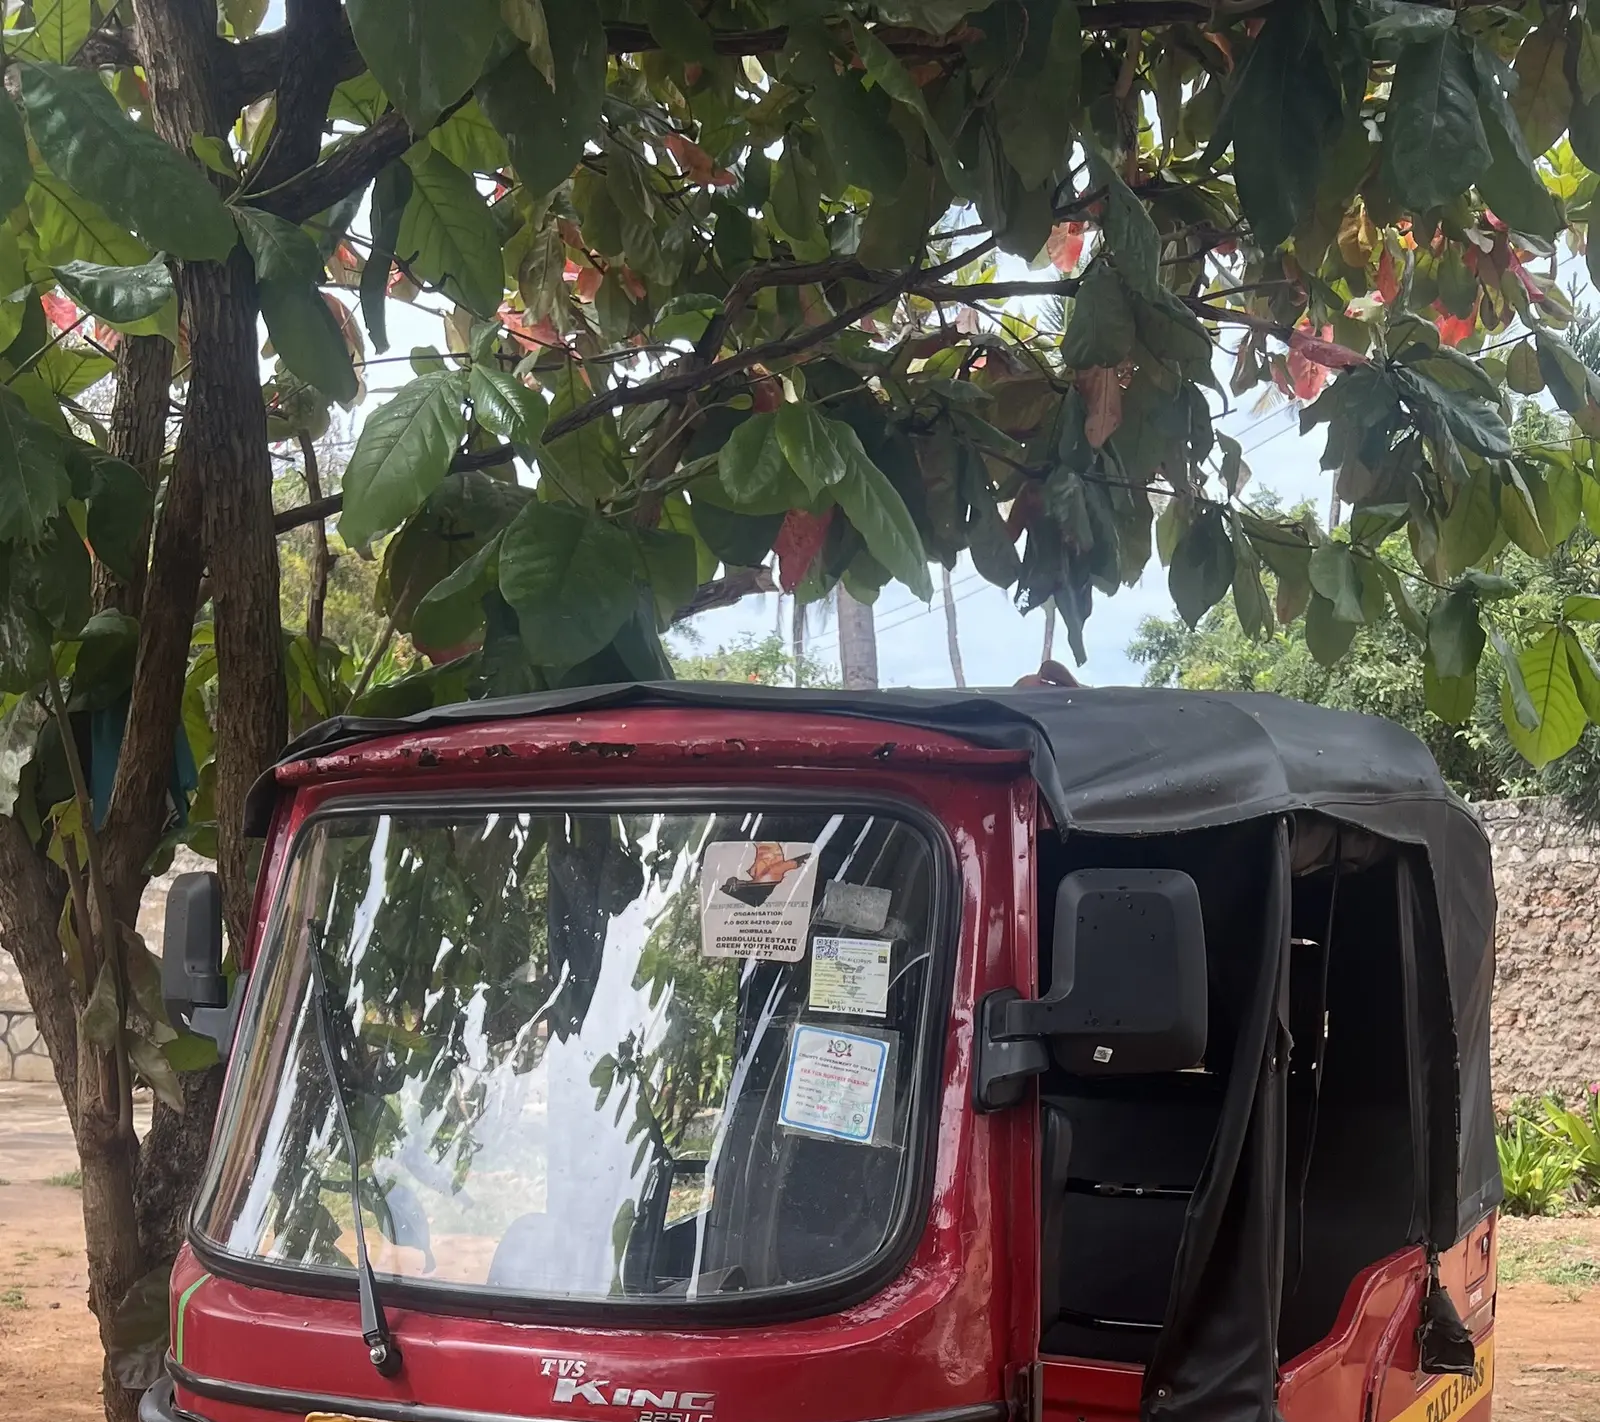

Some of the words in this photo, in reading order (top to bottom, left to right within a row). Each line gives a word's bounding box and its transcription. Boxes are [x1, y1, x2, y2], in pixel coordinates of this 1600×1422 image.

[541, 1358, 587, 1377] TVS
[1453, 1379, 1459, 1412] 3
[1460, 1356, 1485, 1404] PASS
